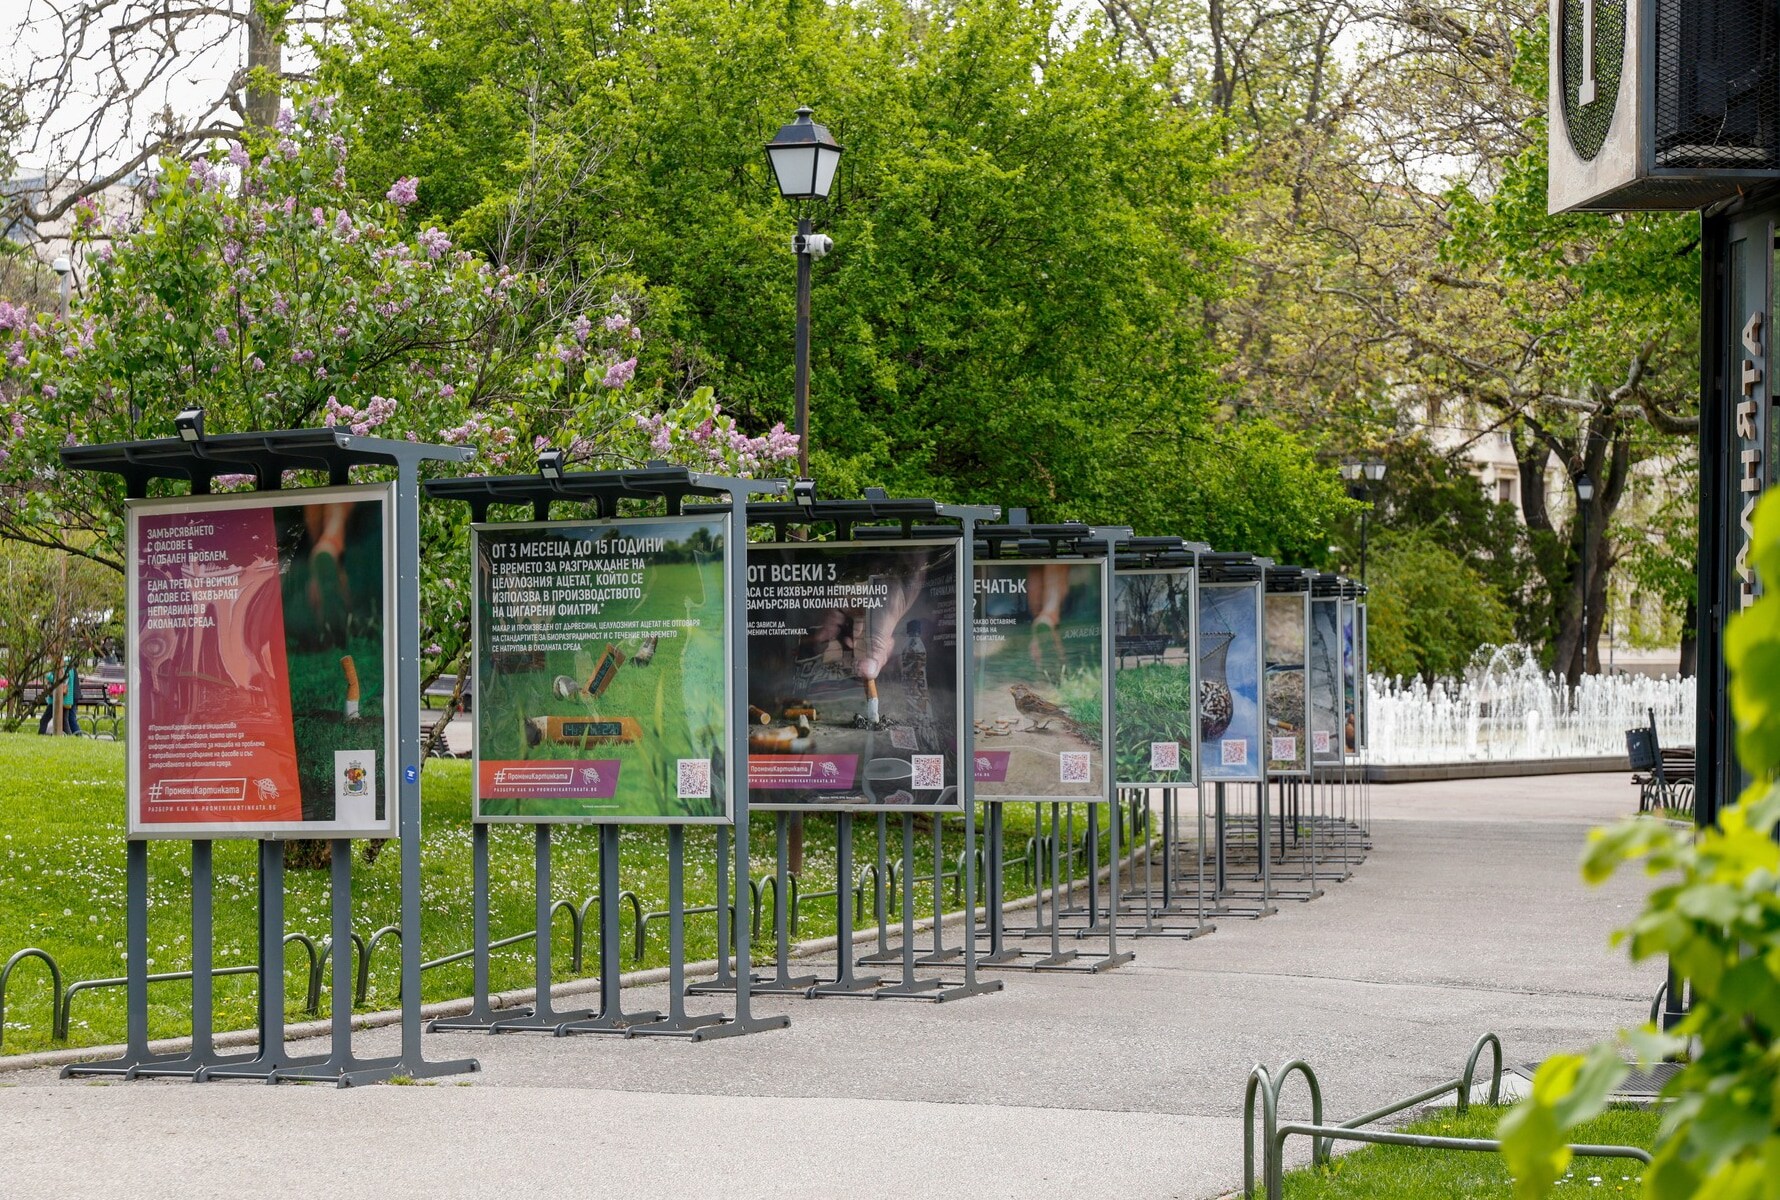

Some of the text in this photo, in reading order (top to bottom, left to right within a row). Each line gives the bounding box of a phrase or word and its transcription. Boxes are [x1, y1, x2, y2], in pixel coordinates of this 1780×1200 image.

[147, 526, 213, 538] ЗАМЪРСЯВАНЕТО
[148, 540, 192, 551] С ФАСОВЕ Е
[492, 538, 663, 558] ОТ 3 МЕСЕЦА ДО 15 ГОДИНИ
[148, 551, 228, 564] ГЛОБАЛЕН ПРОБЛЕМ.
[493, 558, 645, 574] Е ВРЕМЕТО ЗА РАЗГРАЖДАНЕ НА
[748, 564, 836, 582] ОТ ВСЕКИ 3
[148, 576, 238, 592] ЕДНА ТРЕТА ОТ ВСИЧКИ
[492, 571, 643, 590] ЦЕЛУЛОЗНИЯ АЦЕТАТ, КОЙТО СЕ
[974, 579, 1027, 593] ЕЧАТЪК
[148, 589, 238, 603] ФАСОВЕ СЕ ИЗХВЪРЛЯТ
[492, 588, 640, 603] ИЗПОЛЗВА В ПРОИЗВОДСТВОТО
[764, 587, 774, 596] СЕ
[777, 586, 824, 596] ИЗХВЪРЛЯ
[827, 585, 888, 596] НЕПРАВИЛНО
[803, 598, 848, 608] ОКОЛНАТА
[148, 604, 205, 616] НЕПРАВИЛНО В
[492, 606, 504, 617] НА
[506, 604, 555, 618] ЦИГАРЕНИ
[148, 617, 215, 629] ОКОЛНАТА СРЕДА.
[517, 623, 554, 632] ПРОИЗВЕДЕН
[599, 621, 639, 630] ЦЕЛУЛОЗНИЯТ
[500, 634, 537, 642] СТАНДАРТИТЕ
[547, 632, 602, 641] БИОРАЗГРАДИМОСТ
